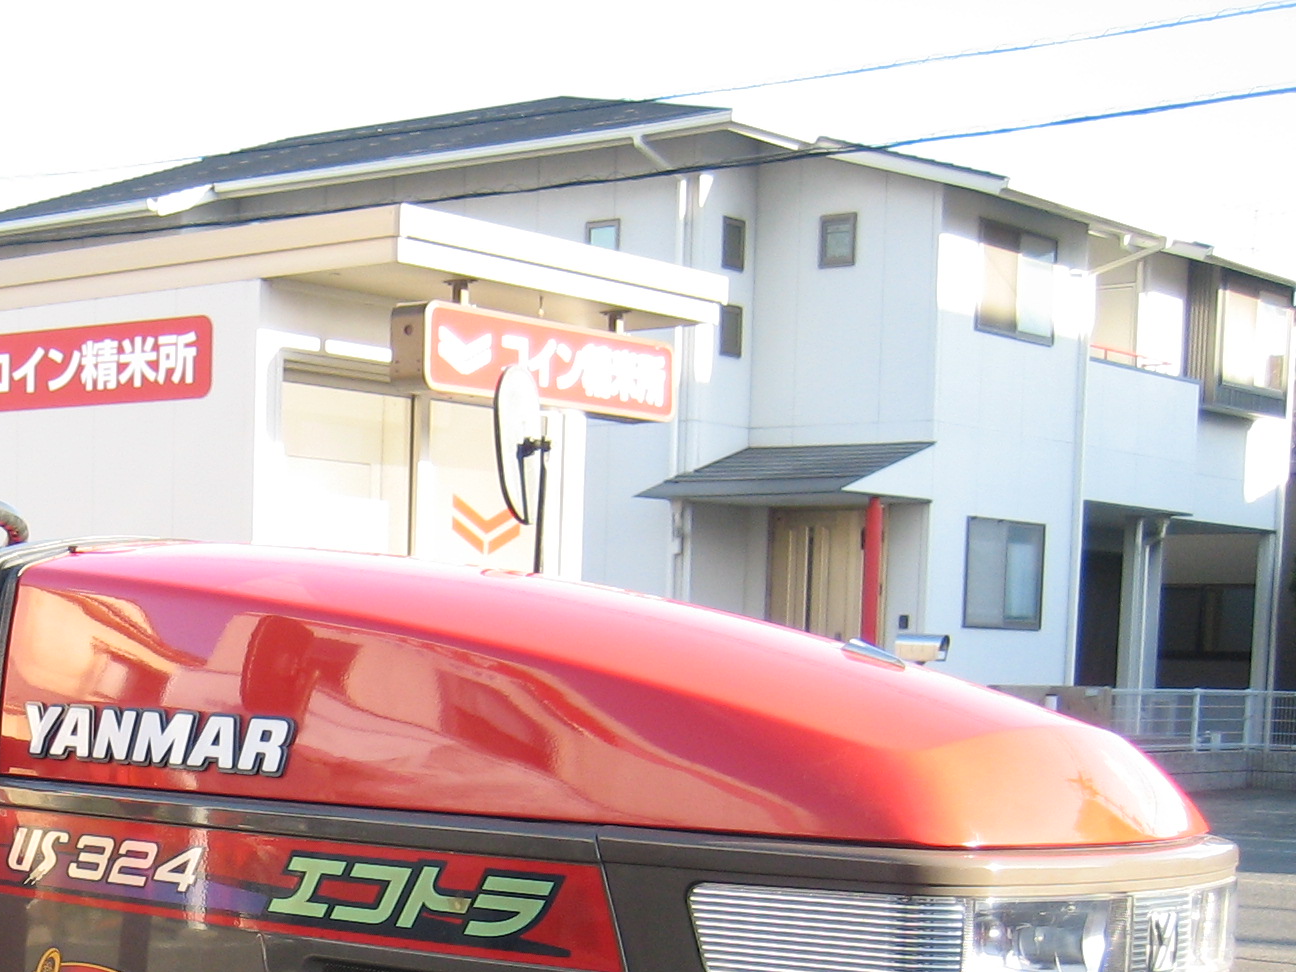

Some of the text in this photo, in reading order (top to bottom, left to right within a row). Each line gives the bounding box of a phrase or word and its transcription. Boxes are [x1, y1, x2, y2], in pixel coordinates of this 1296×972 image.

[24, 702, 295, 777] YANMAR
[266, 855, 555, 938] エコトラ
